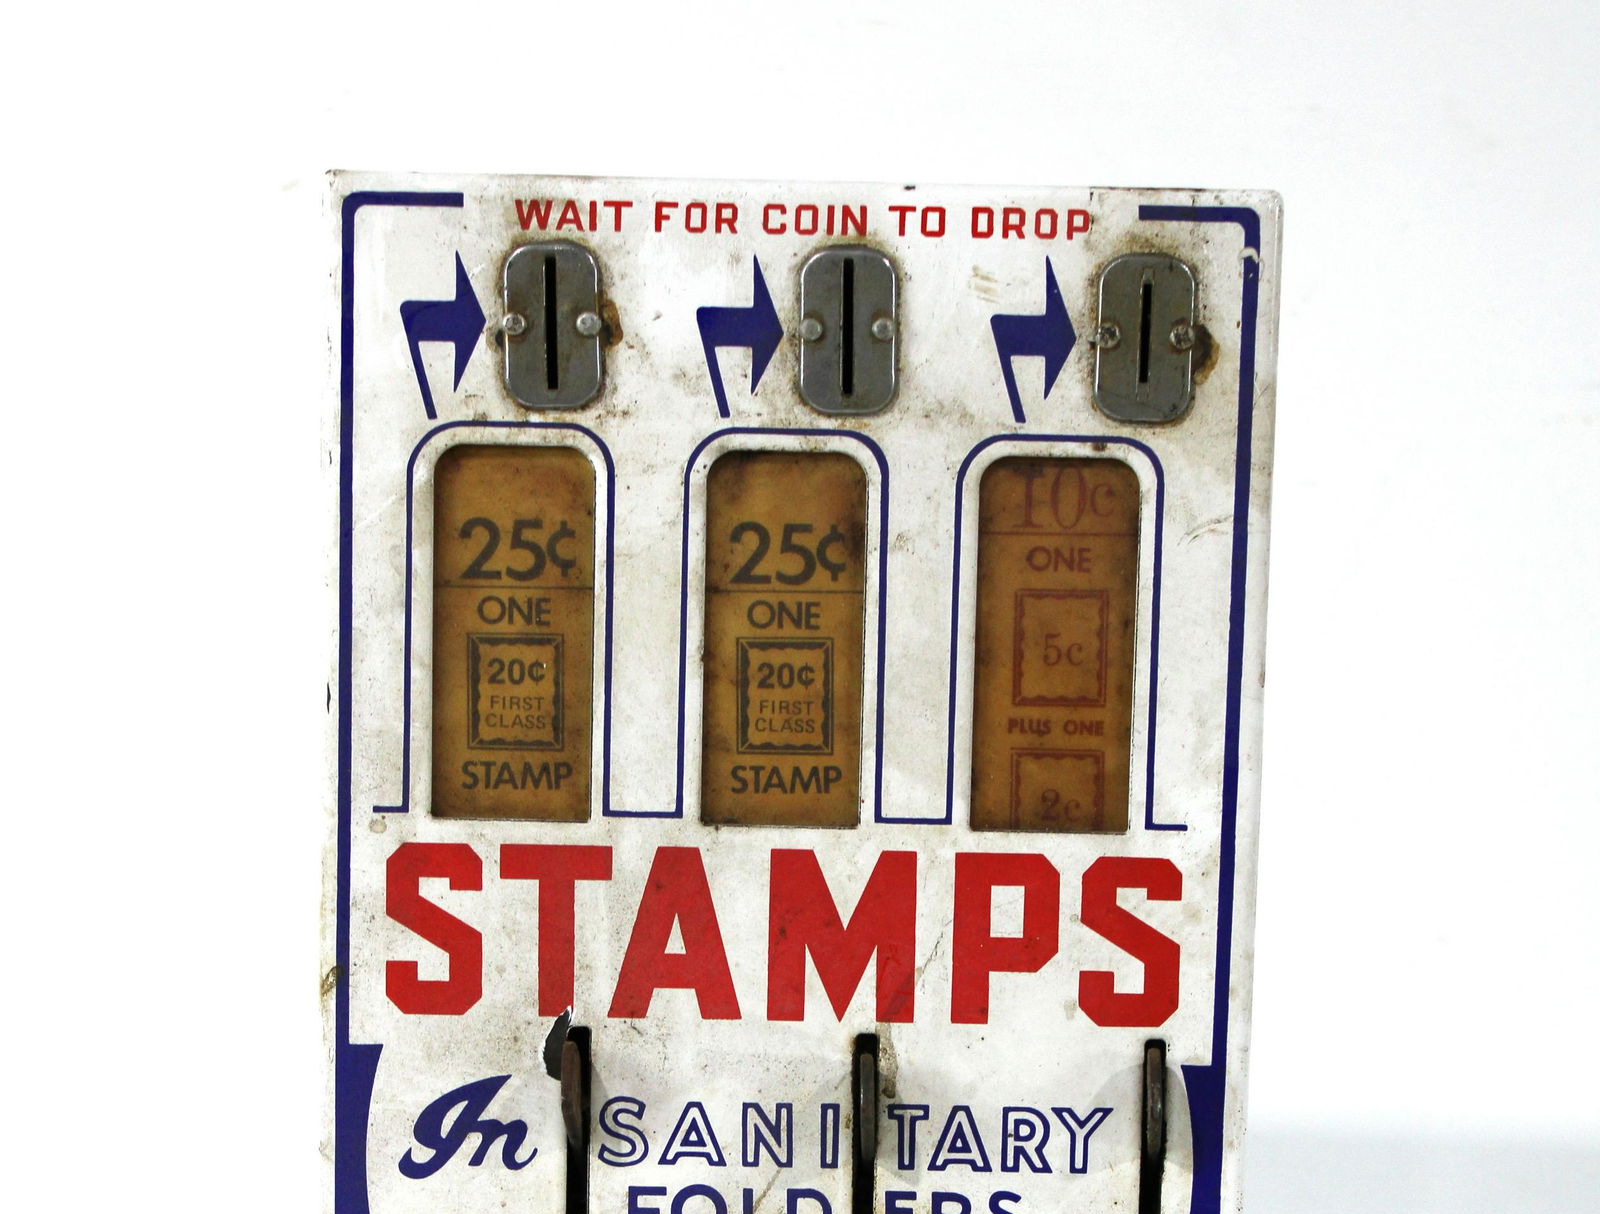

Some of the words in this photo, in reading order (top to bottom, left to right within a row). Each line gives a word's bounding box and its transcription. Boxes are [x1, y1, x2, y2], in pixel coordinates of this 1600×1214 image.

[515, 199, 633, 233] WAIT
[653, 201, 738, 235] FOR
[761, 203, 868, 237] COIN
[888, 205, 946, 239] TO
[970, 206, 1091, 241] DROP
[458, 516, 577, 582] 25¢
[728, 521, 847, 585] 25¢
[1026, 545, 1092, 573] ONE
[476, 595, 552, 627] ONE
[746, 599, 821, 631] ONE
[1042, 633, 1084, 666] 5c
[487, 658, 546, 687] 20¢
[757, 661, 816, 691] 20¢
[489, 695, 545, 712] FIRST
[758, 699, 815, 715] FIRST
[485, 712, 547, 730] CLASS
[754, 716, 816, 734] CLASS
[1007, 718, 1052, 736] PLUS
[1063, 718, 1105, 737] ONE
[461, 760, 573, 790] STAMP
[730, 765, 843, 795] STAMP
[1040, 788, 1081, 823] 2c
[385, 842, 1184, 1028] STAMPS
[397, 1073, 538, 1180] In
